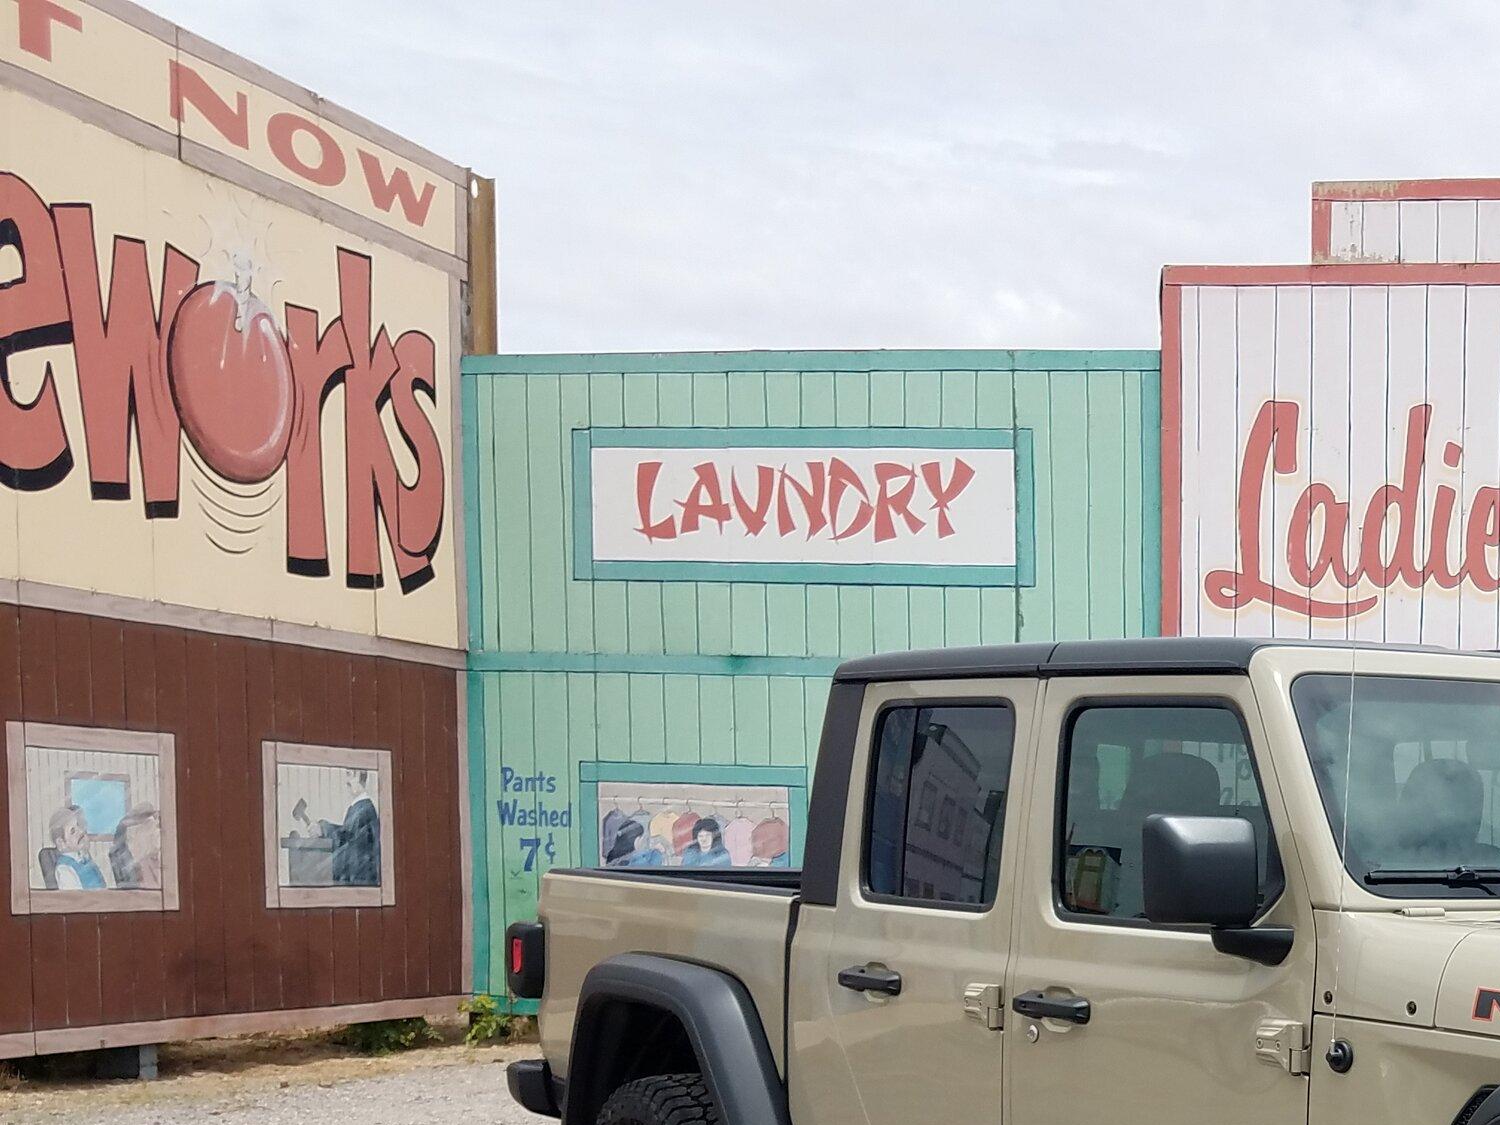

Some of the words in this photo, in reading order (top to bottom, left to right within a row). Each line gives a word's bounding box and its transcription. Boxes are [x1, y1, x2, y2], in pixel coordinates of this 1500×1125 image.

[168, 58, 437, 228] NOW
[633, 456, 977, 544] LAUNDRY
[501, 766, 556, 793] Pants
[497, 799, 572, 828] Washed
